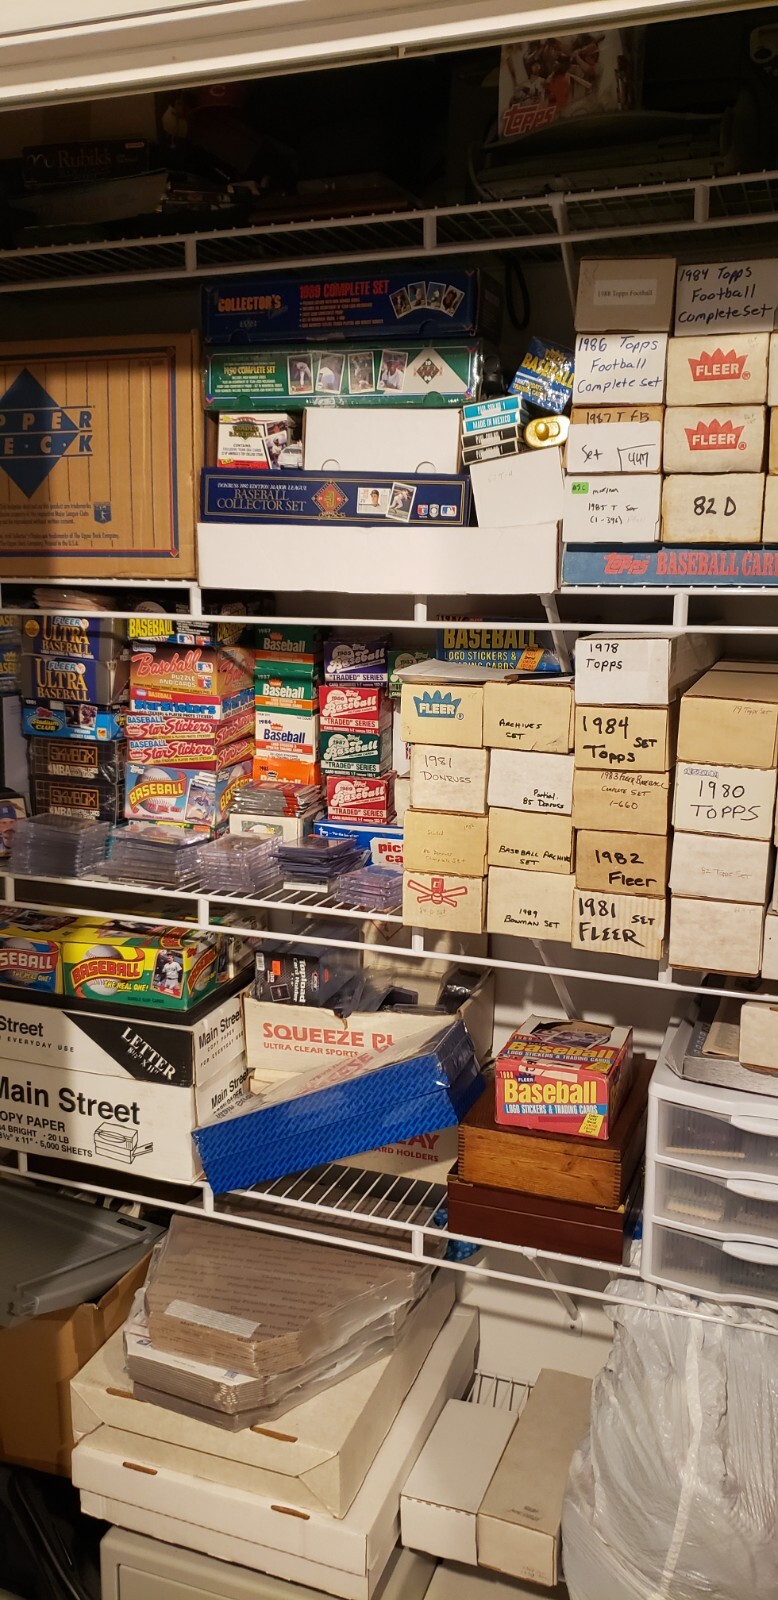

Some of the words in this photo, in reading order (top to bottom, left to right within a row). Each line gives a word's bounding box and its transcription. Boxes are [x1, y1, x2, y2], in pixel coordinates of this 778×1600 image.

[680, 268, 709, 282] 1984
[717, 266, 752, 284] Topps
[323, 281, 370, 297] COMPLETE
[373, 280, 390, 294] SET
[612, 290, 629, 299] Topps
[630, 289, 652, 297] Football
[692, 284, 756, 303] Football
[218, 294, 282, 312] COLLECTOR'S
[577, 337, 607, 352] 1986
[621, 336, 658, 353] Topps
[237, 366, 266, 375] COMPLETE
[266, 365, 276, 374] SET
[521, 351, 575, 389] BASEBALL
[591, 358, 646, 373] Football
[696, 363, 740, 377] FLEER
[577, 377, 635, 394] Complete
[473, 420, 487, 429] MADE
[487, 419, 492, 428] IN
[493, 415, 511, 427] MEXICO
[692, 433, 736, 446] FLEER
[582, 444, 603, 463] Set
[234, 489, 289, 500] BASEBALL
[217, 498, 284, 511] COLLECTOR
[285, 501, 306, 511] SET
[693, 496, 716, 516] 82
[724, 496, 736, 516] D
[656, 551, 739, 576] BASEBALL
[54, 617, 79, 625] FLEER
[129, 618, 174, 637] BASEBALL
[43, 615, 90, 644] ULTRA
[264, 638, 305, 652] Baseball
[443, 629, 539, 649] BASEBALL
[42, 640, 91, 654] BASEBALL
[590, 643, 619, 653] 1978
[131, 648, 202, 677] Baseball
[327, 648, 385, 673] Baseball
[445, 652, 464, 660] LOGO
[468, 651, 508, 660] STICKERS
[511, 652, 516, 660] &
[48, 661, 76, 670] FLEER
[585, 658, 623, 672] Topps
[35, 658, 88, 691] ULTRA
[171, 674, 195, 682] PUZZLE
[174, 680, 196, 688] CARDS
[263, 684, 305, 699] Baseball
[37, 687, 90, 701] BASEBALL
[148, 691, 172, 699] BASEBALL
[322, 696, 376, 717] Baseball
[420, 703, 455, 715] FLEER
[127, 716, 164, 724] BASEBALL
[355, 719, 376, 727] SERIES
[583, 716, 629, 739] 1984
[130, 740, 168, 748] BASEBALL
[264, 729, 305, 744] Baseball
[50, 748, 95, 763] SKYBOX
[324, 740, 378, 760] Baseball
[583, 744, 636, 764] Topps
[633, 736, 658, 749] SET
[356, 763, 377, 771] SERIES
[424, 755, 452, 768] 1981
[52, 765, 71, 776] NBA
[420, 771, 472, 784] DONRUSS
[129, 783, 184, 805] BASEBALL
[331, 786, 385, 806] Baseball
[699, 780, 745, 799] 1980
[52, 790, 96, 805] SKYBOX
[363, 809, 384, 817] SERIES
[690, 804, 761, 821] TOPPS
[595, 850, 644, 864] 1982
[609, 871, 657, 887] Fleer
[579, 898, 616, 918] 1981
[544, 920, 560, 928] SET
[579, 922, 645, 948] FLEER
[631, 914, 656, 925] SET
[72, 961, 142, 984] BASEBALL
[104, 980, 116, 988] THE
[117, 982, 132, 991] REAL
[133, 984, 149, 992] ONE!
[0, 1015, 44, 1037] Street
[7, 1036, 51, 1048] EVERYDAY
[198, 1026, 218, 1049] Main
[262, 1022, 365, 1047] SQUEEZE
[121, 1026, 176, 1080] LETTER
[263, 1042, 292, 1051] ULTRA
[294, 1044, 323, 1054] CLEAR
[508, 1041, 614, 1059] Baseball
[211, 1088, 228, 1109] Main
[504, 1079, 597, 1104] Baseball
[58, 1087, 140, 1125] Street
[505, 1104, 520, 1113] LOGO
[521, 1105, 546, 1114] STICKERS
[548, 1105, 554, 1113] &
[555, 1105, 579, 1114] TRADING
[579, 1105, 598, 1114] CARDS
[27, 1115, 65, 1132] PAPER
[8, 1125, 37, 1137] BRIGHT
[48, 1132, 57, 1142] 20
[58, 1135, 69, 1144] LB
[40, 1140, 59, 1152] 5,000
[61, 1143, 93, 1158] SHEETS
[396, 1149, 440, 1163] HOLDERS
